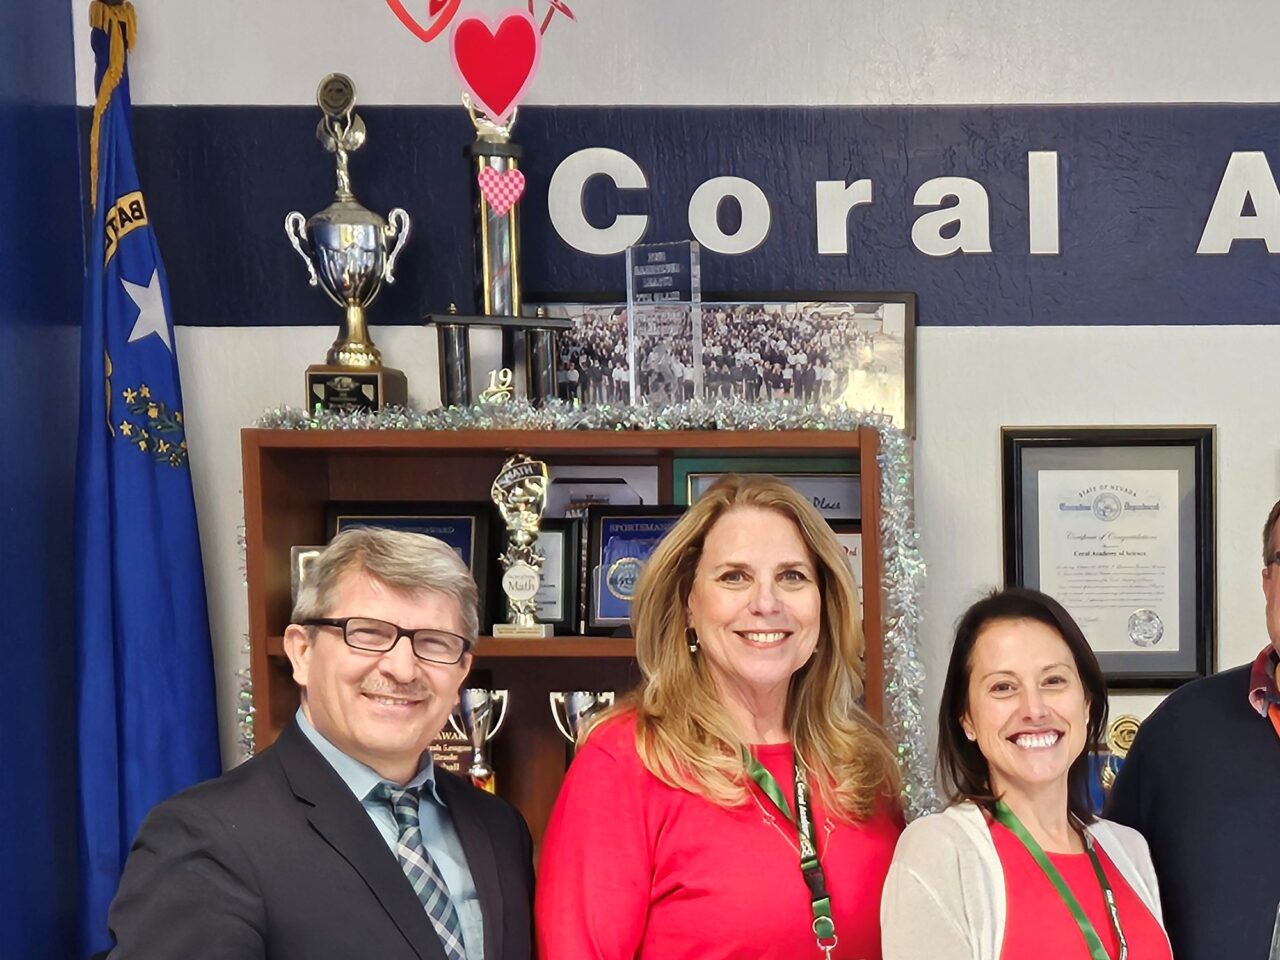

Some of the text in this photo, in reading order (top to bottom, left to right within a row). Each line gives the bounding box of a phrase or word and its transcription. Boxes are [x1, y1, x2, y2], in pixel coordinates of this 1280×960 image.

[548, 147, 1059, 256] Coral
[487, 368, 513, 389] 19
[1078, 487, 1097, 498] STATE
[1110, 485, 1138, 498] NEVADA
[508, 579, 535, 591] Math
